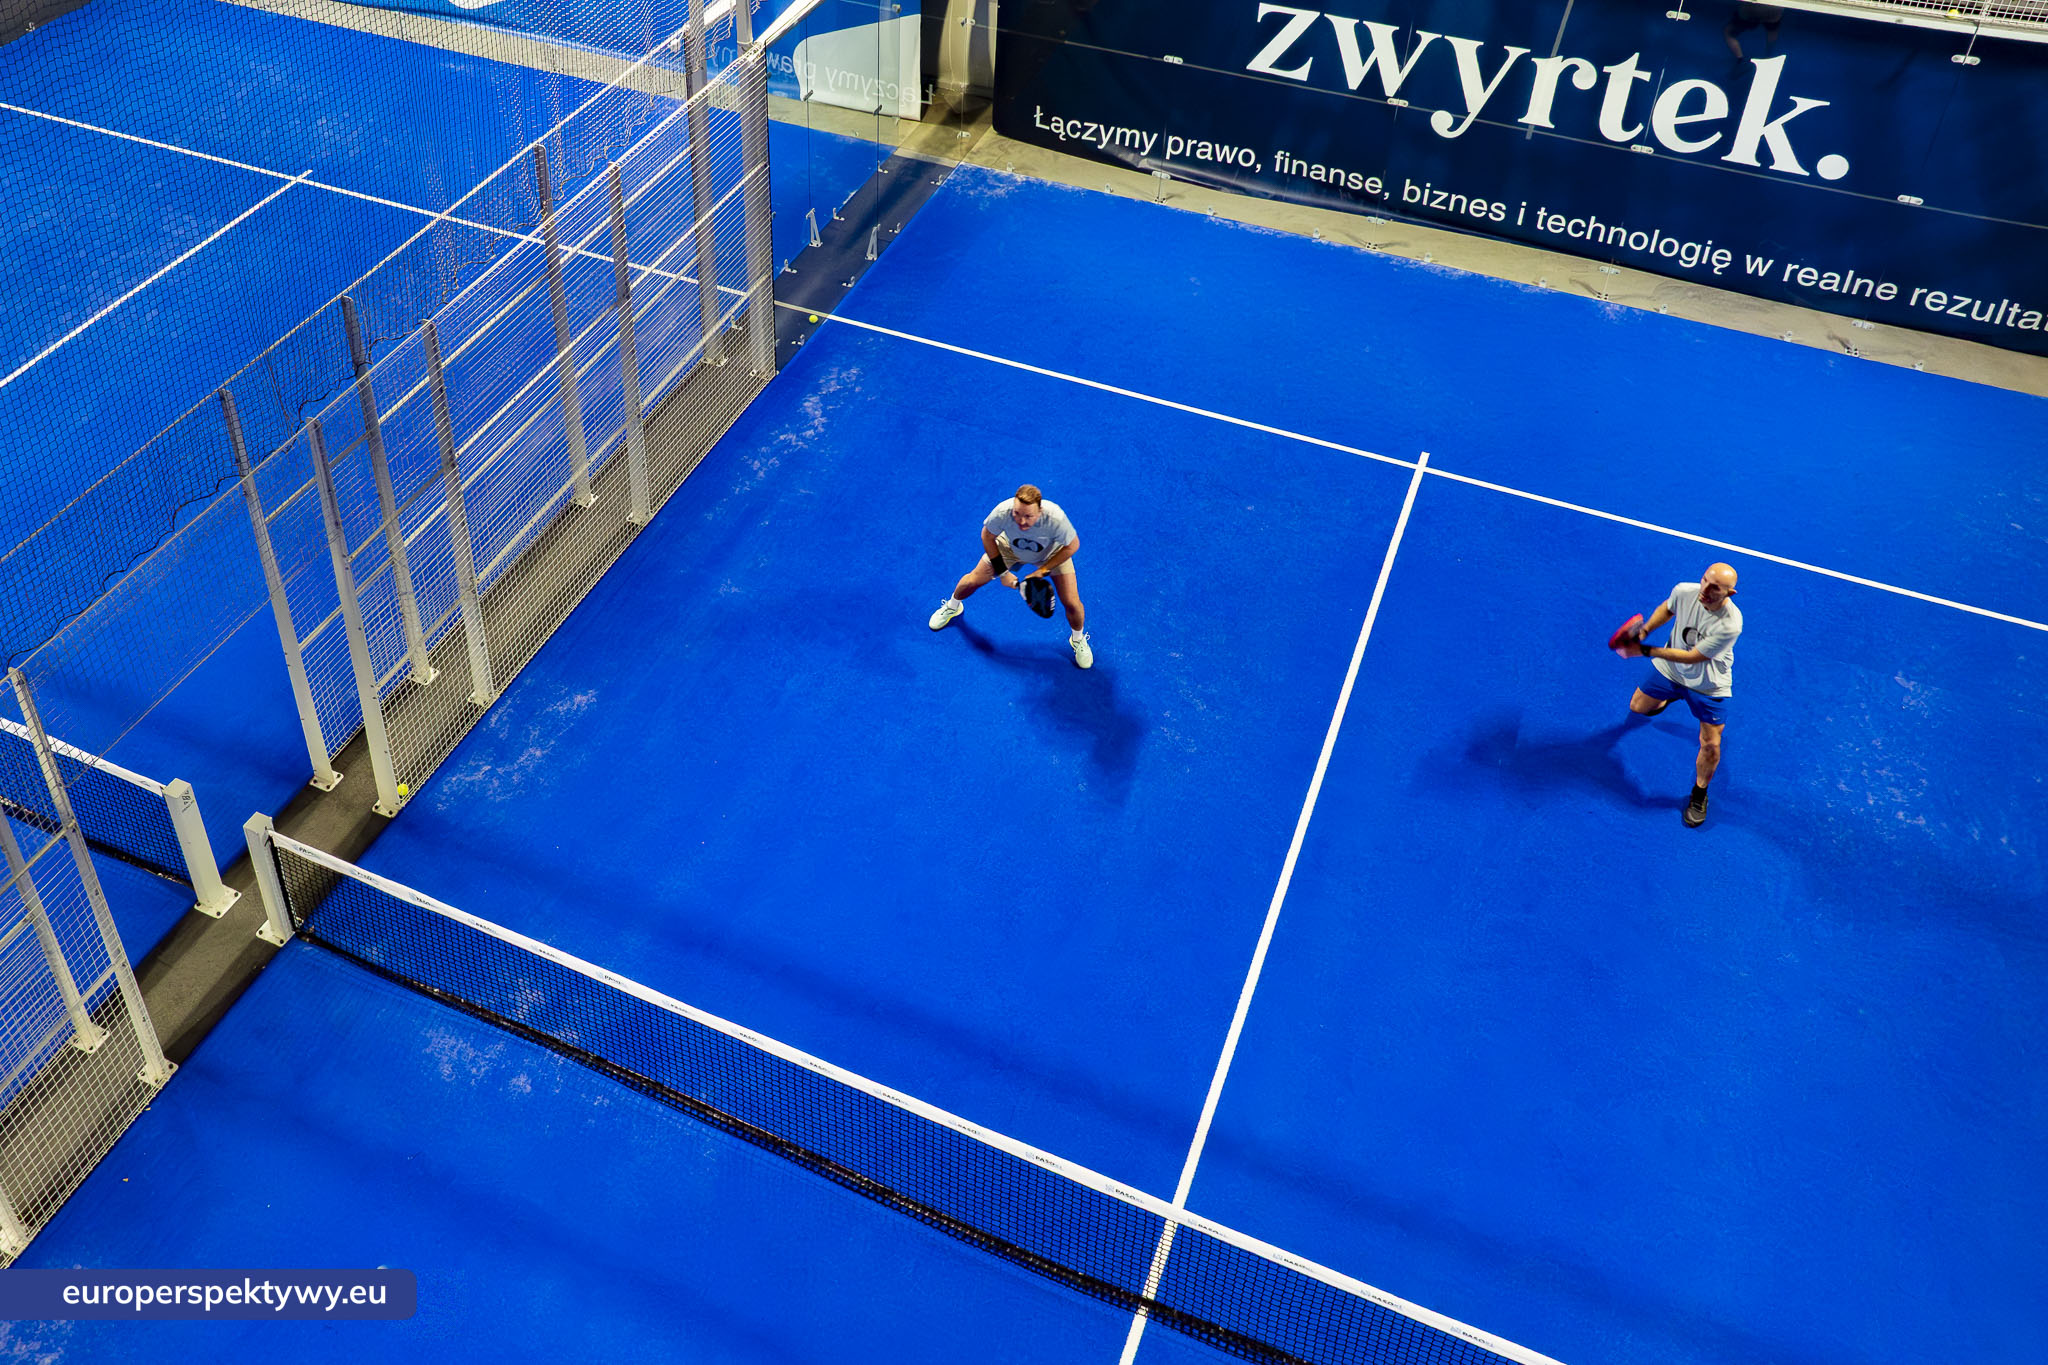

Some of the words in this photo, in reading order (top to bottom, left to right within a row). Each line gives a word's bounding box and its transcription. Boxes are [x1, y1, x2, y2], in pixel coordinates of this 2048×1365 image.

[1247, 3, 1848, 180] zwyrtek.
[1034, 106, 1158, 156] Łączymy
[1166, 136, 1262, 172] prawo,
[1275, 151, 1390, 200] finanse,
[1403, 179, 1506, 221] biznes
[1517, 202, 1526, 225] i
[1537, 207, 1731, 274] technologię
[1746, 255, 1773, 276] w
[1783, 264, 1897, 300] realne
[1910, 288, 2048, 332] rezulta
